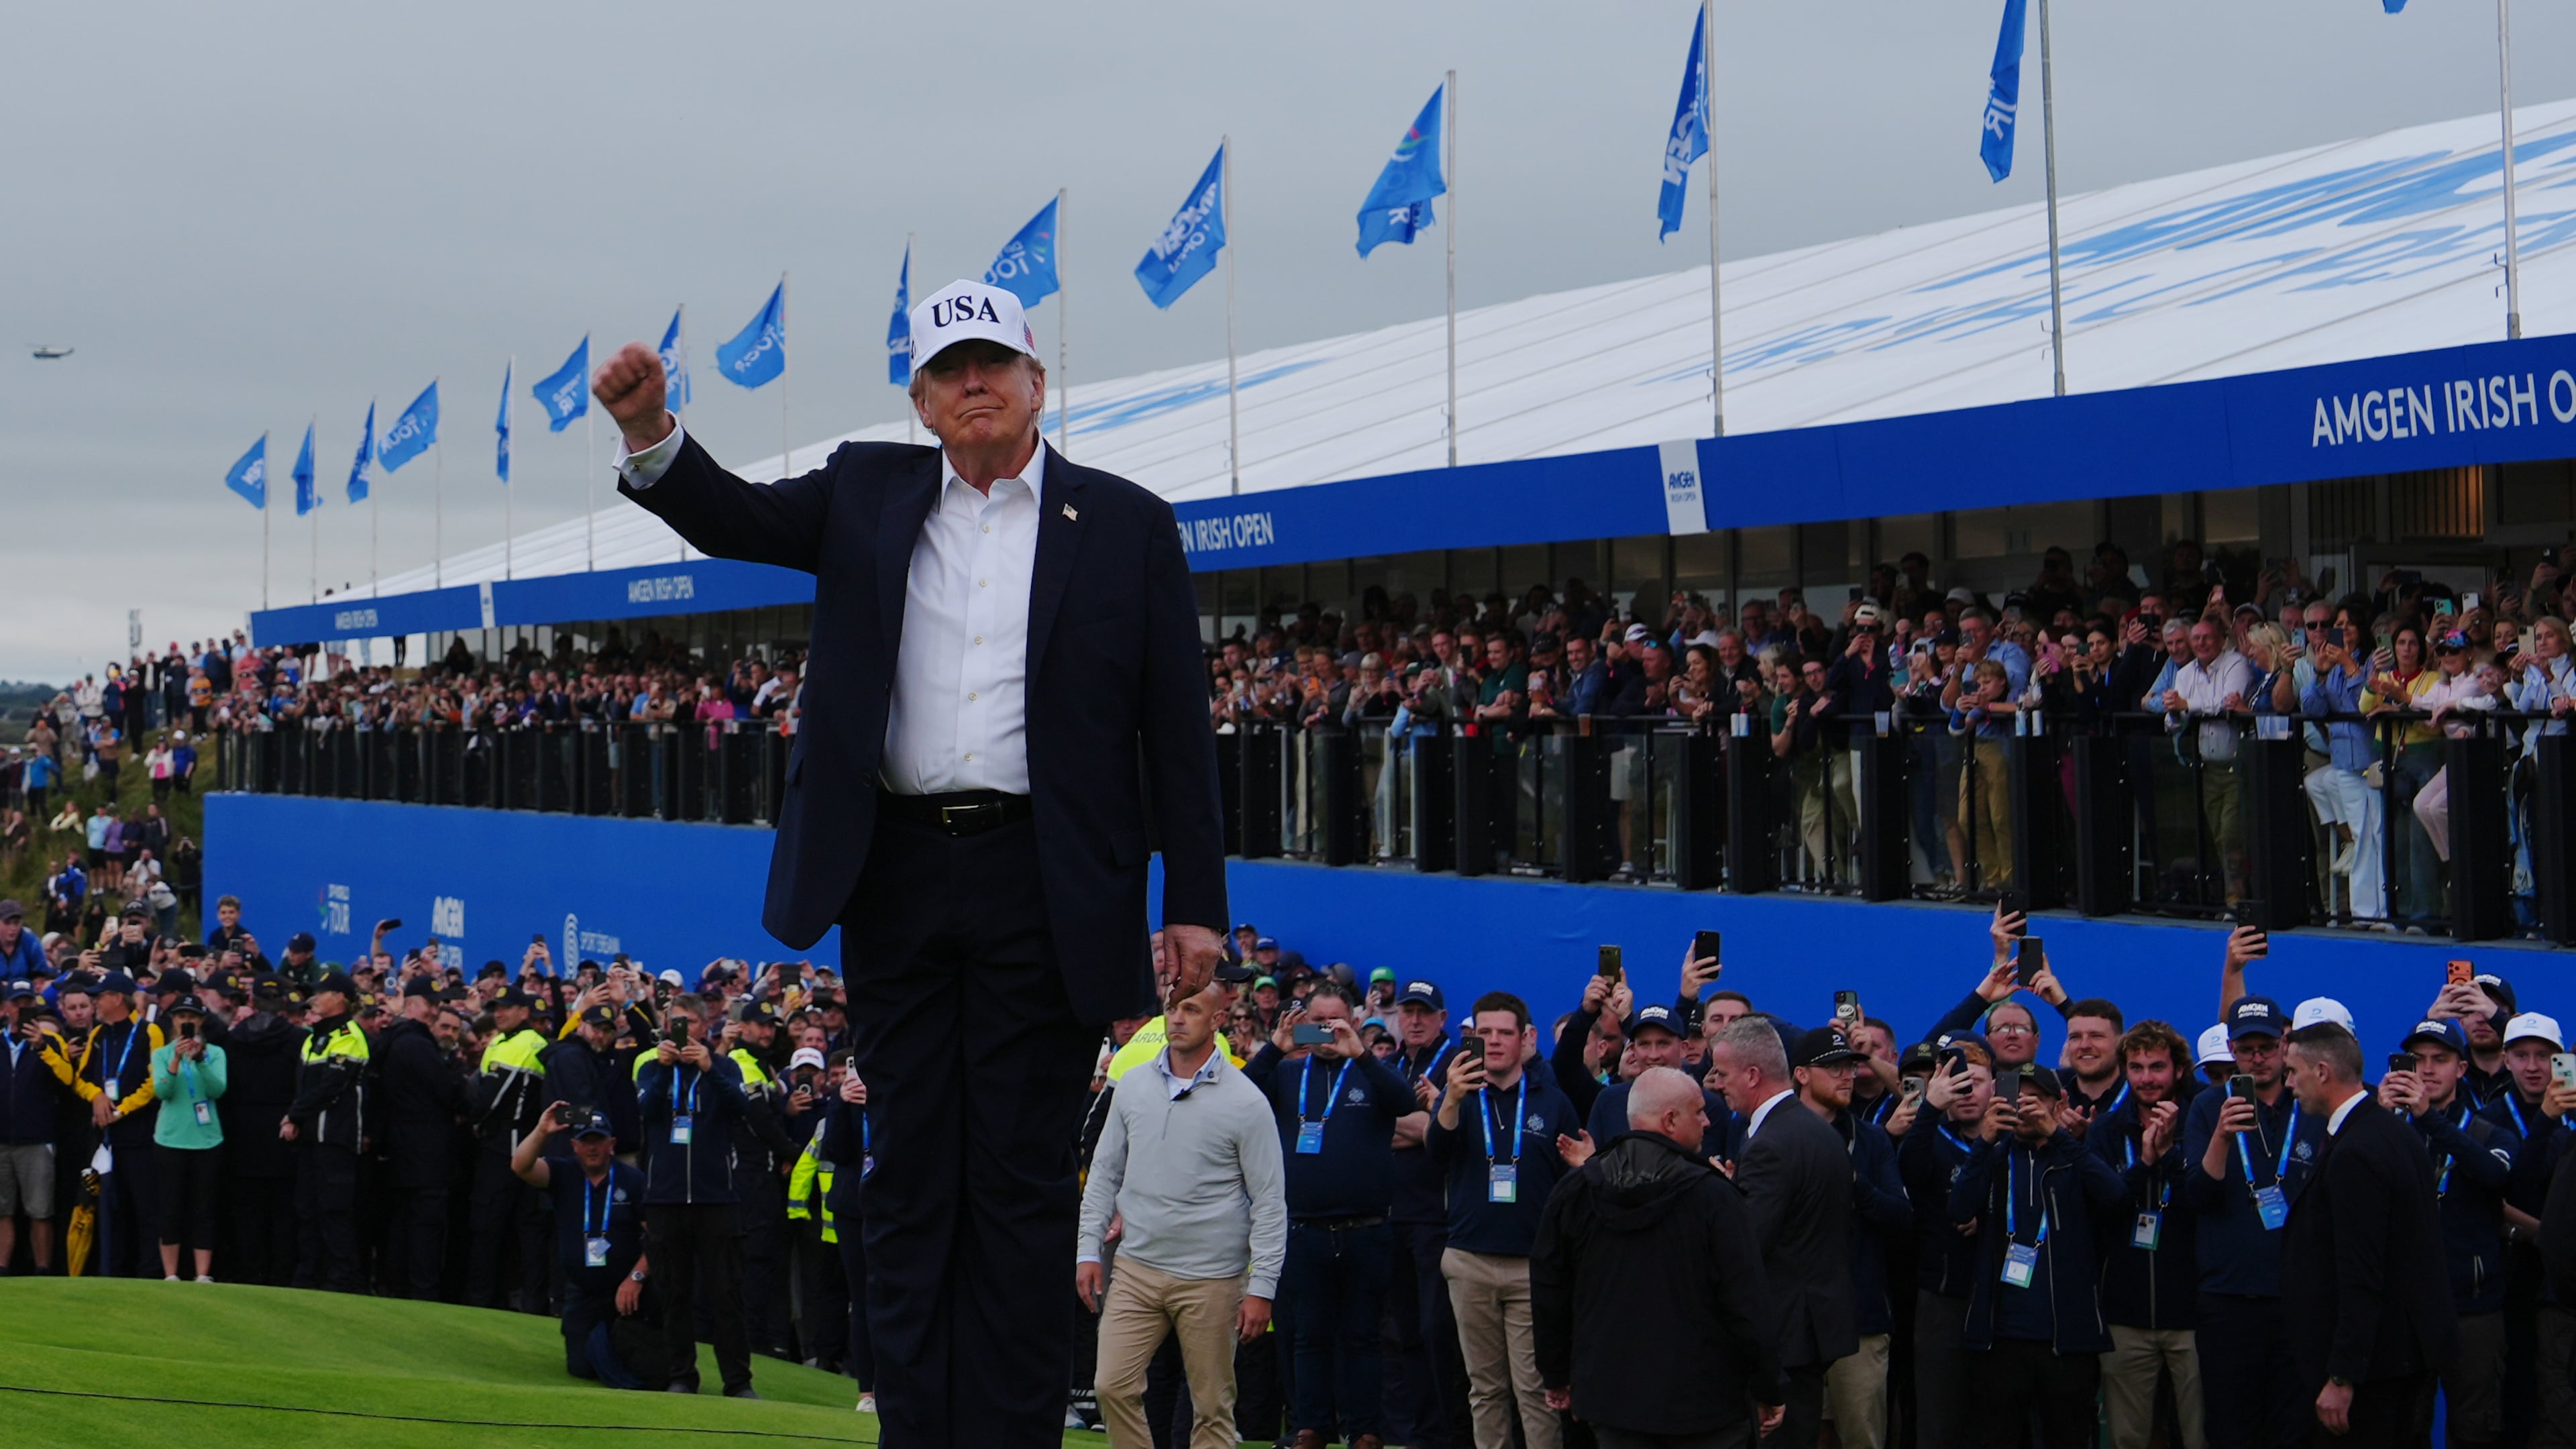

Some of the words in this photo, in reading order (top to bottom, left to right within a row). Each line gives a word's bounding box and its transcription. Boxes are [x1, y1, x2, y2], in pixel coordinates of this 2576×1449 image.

[931, 295, 1000, 327] USA
[2312, 384, 2435, 447] AMGEN
[2444, 373, 2538, 433] IRISH
[1195, 516, 1232, 553] IRISH
[1233, 511, 1274, 548] OPEN
[2238, 1003, 2268, 1014] AMGEN
[1132, 1032, 1166, 1043] ARDA
